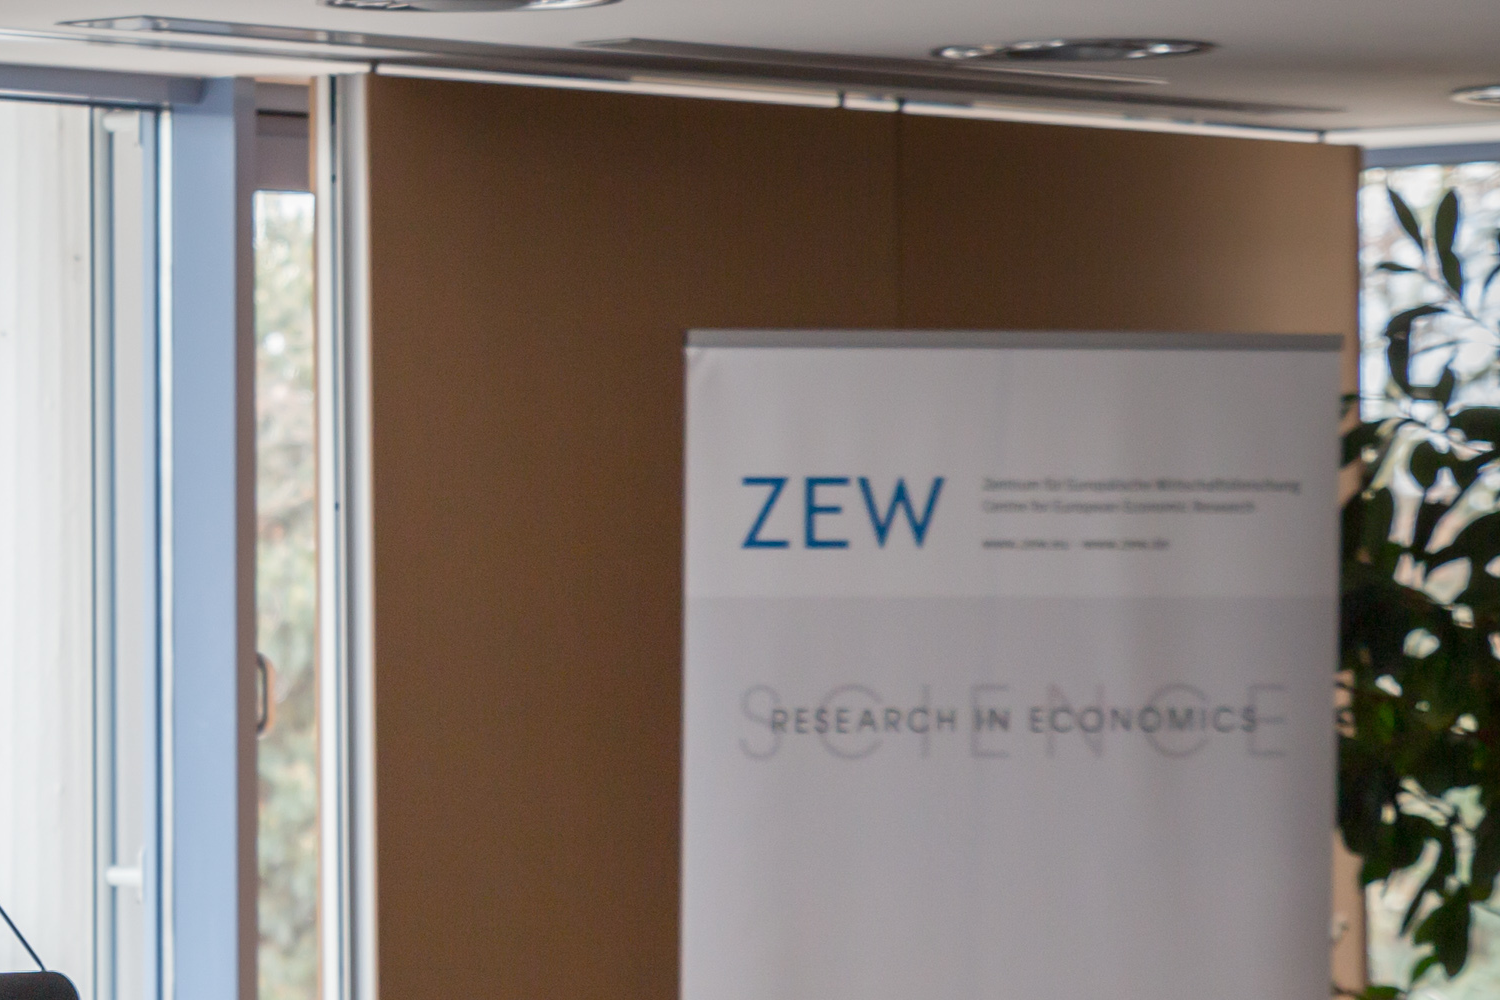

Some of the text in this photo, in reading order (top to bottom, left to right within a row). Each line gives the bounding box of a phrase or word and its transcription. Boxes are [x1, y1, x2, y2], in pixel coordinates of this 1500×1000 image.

[740, 476, 946, 550] ZEW
[739, 683, 1288, 761] SCIENCE
[771, 705, 1258, 734] RESEARCH IN ECONOMICS
